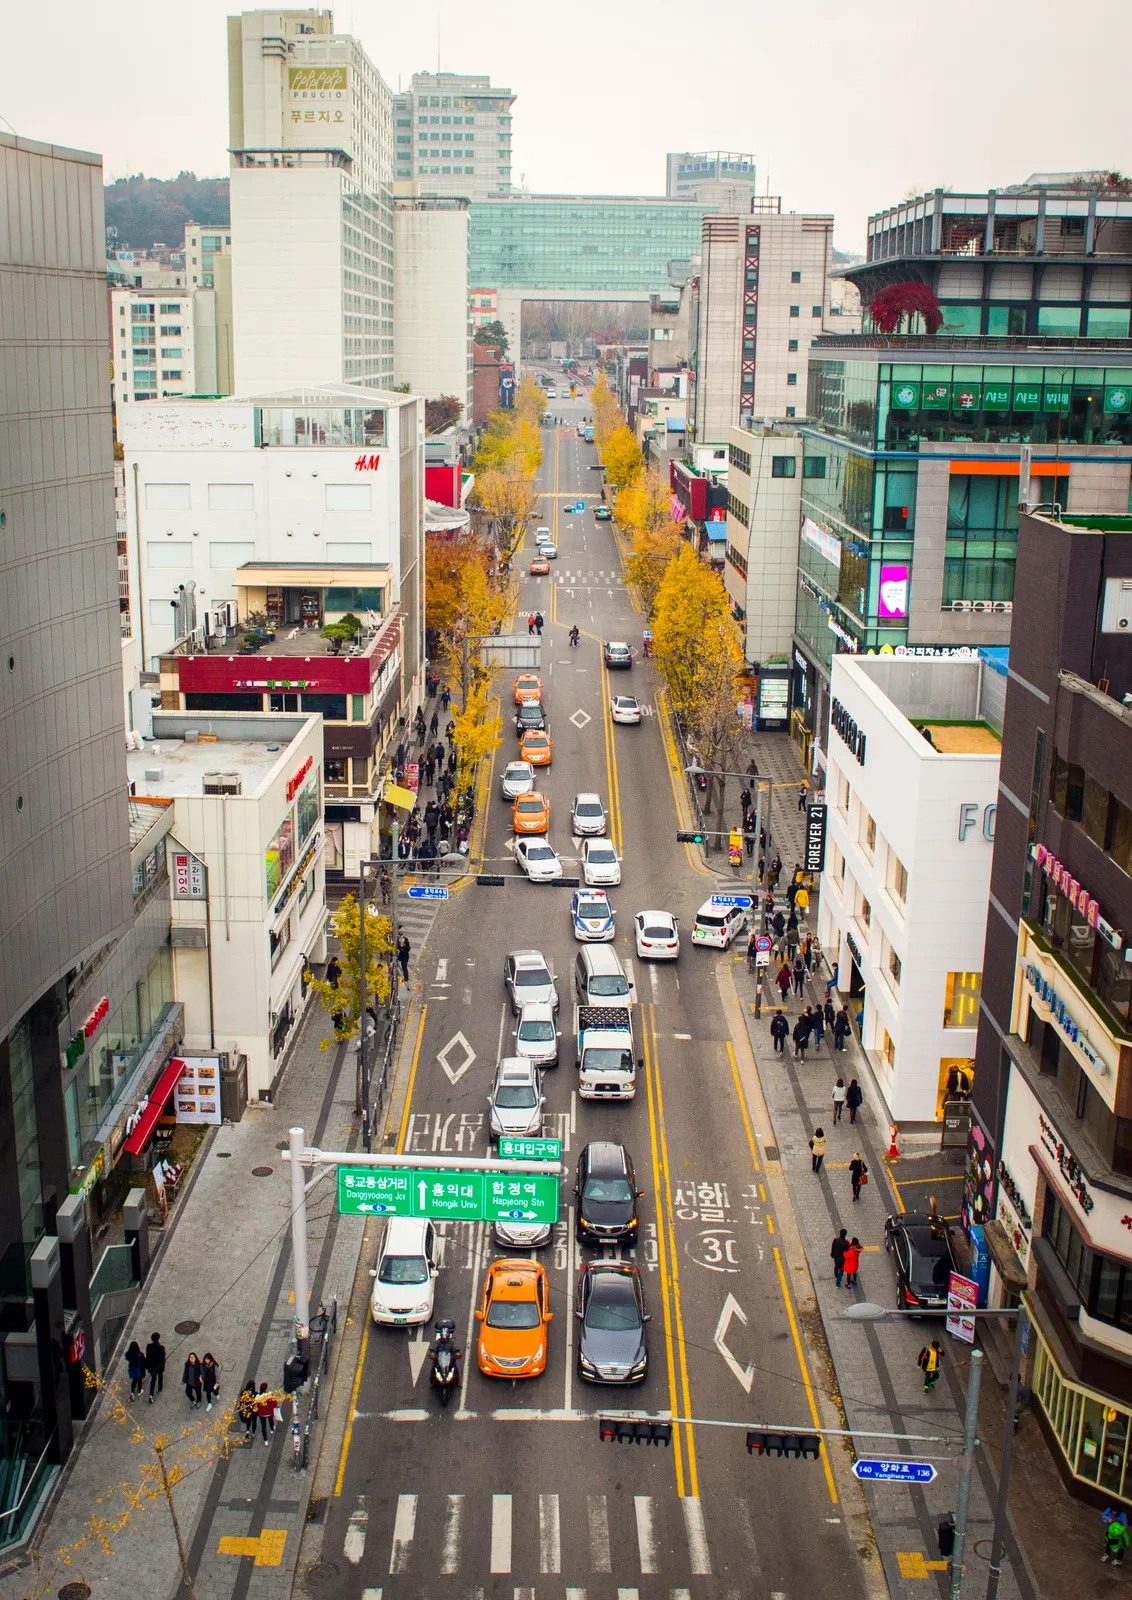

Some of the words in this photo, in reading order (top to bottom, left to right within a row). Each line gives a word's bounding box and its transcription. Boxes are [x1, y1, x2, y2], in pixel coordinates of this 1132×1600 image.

[290, 110, 345, 124] 푸르지오
[986, 391, 1008, 404] 샤브
[1015, 392, 1038, 404] 샤브
[354, 454, 380, 471] H&M
[807, 821, 823, 871] FOREVER
[815, 805, 823, 818] 21
[192, 866, 200, 874] 2F
[177, 868, 188, 894] 다이소
[192, 876, 200, 884] 1F
[192, 886, 201, 894] B1
[502, 1141, 558, 1156] 홍대입구역
[344, 1175, 408, 1190] 동교동삼거리
[492, 1181, 536, 1196] 합정역
[346, 1190, 393, 1201] Donggyodong
[395, 1192, 406, 1201] Jct
[432, 1183, 473, 1198] 홍익대
[376, 1204, 382, 1212] 6
[432, 1198, 458, 1210] Hongik
[461, 1200, 478, 1209] Univ
[492, 1197, 529, 1208] Hapjeong
[531, 1198, 545, 1207] Stn
[880, 1463, 910, 1473] 양화로
[917, 1469, 930, 1477] 136
[875, 1472, 915, 1480] Yanghwa-ro
